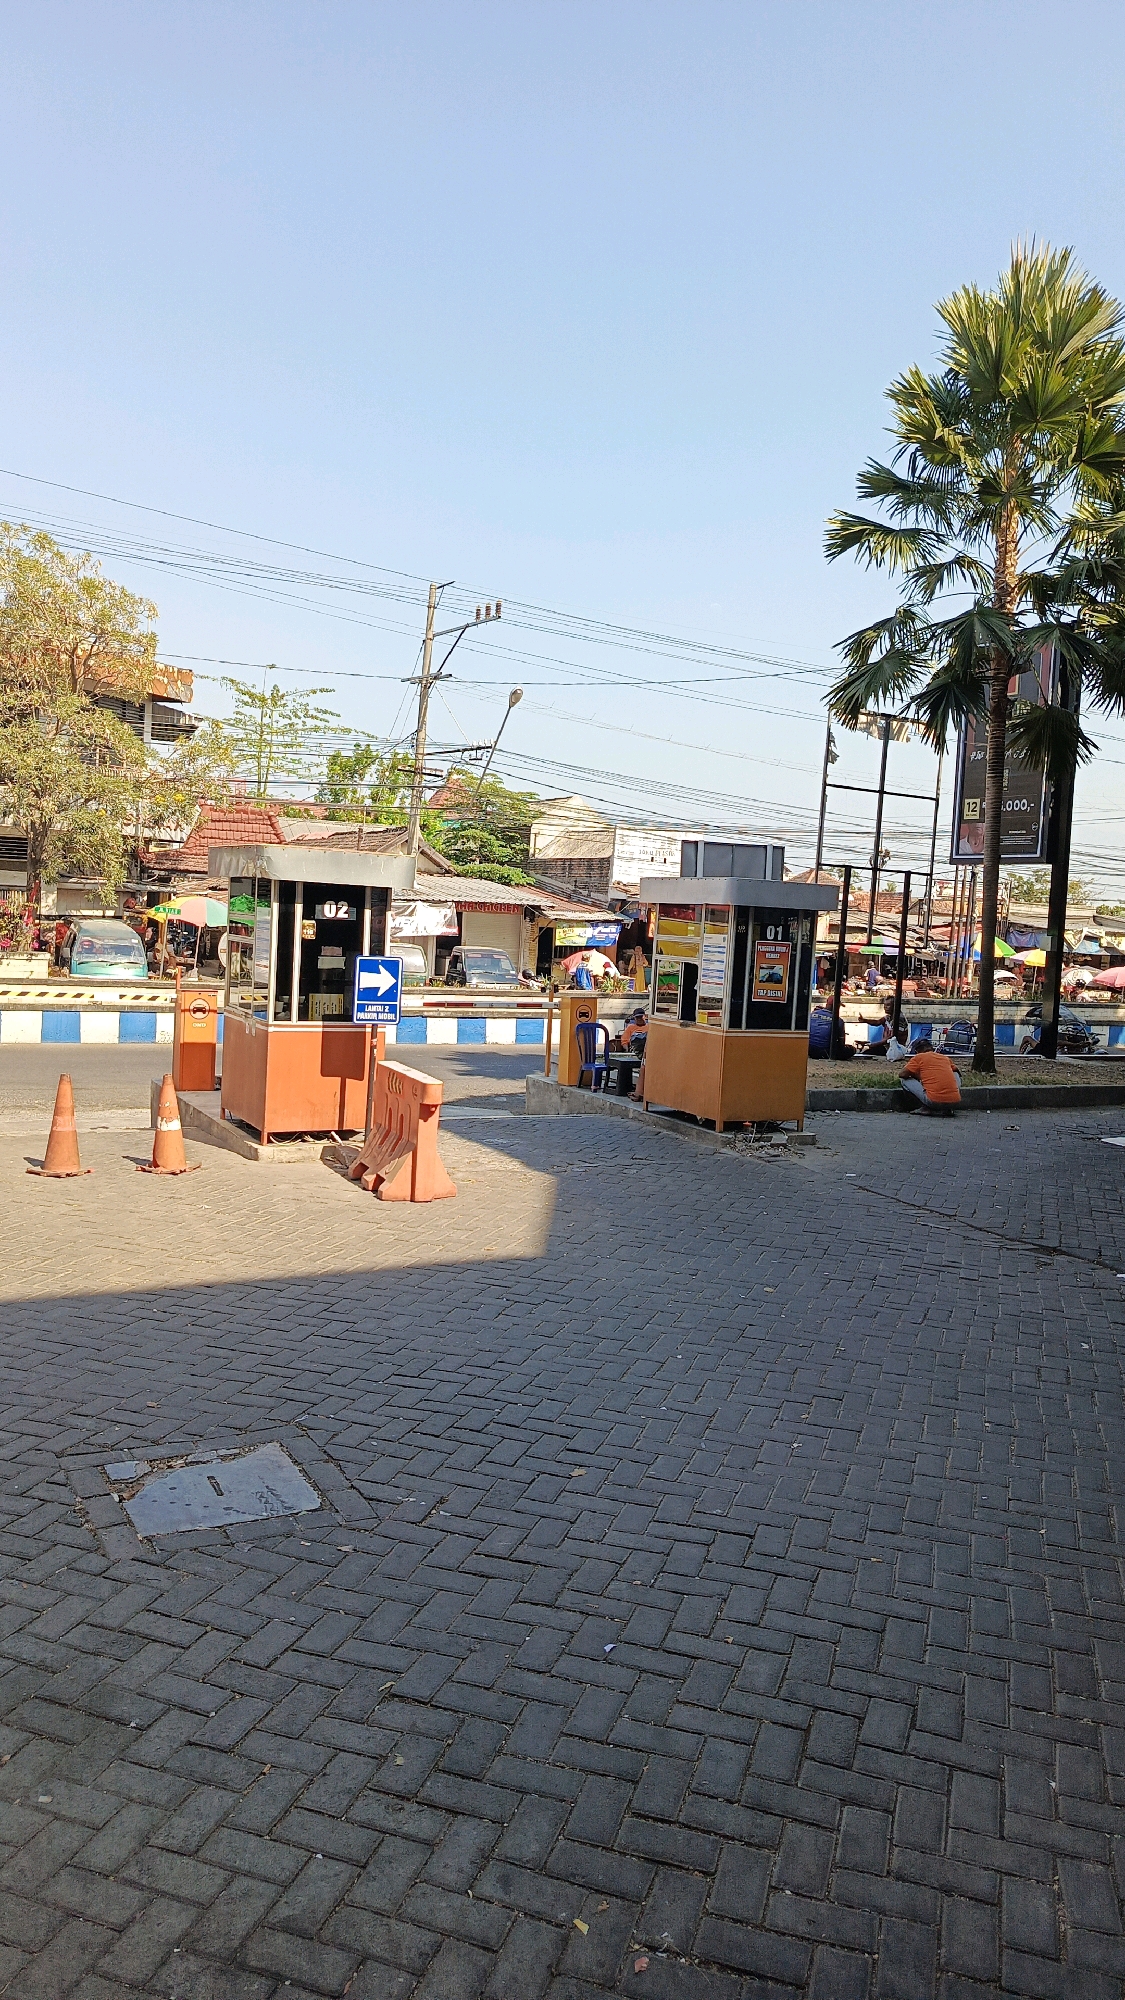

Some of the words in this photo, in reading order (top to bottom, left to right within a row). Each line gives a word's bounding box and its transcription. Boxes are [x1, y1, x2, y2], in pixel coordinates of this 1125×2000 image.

[966, 802, 978, 813] 12
[323, 900, 349, 918] 02
[477, 902, 520, 914] CHICKEN
[766, 925, 783, 941] 01
[357, 1012, 378, 1020] PARKIR
[378, 1012, 396, 1020] MOBIL
